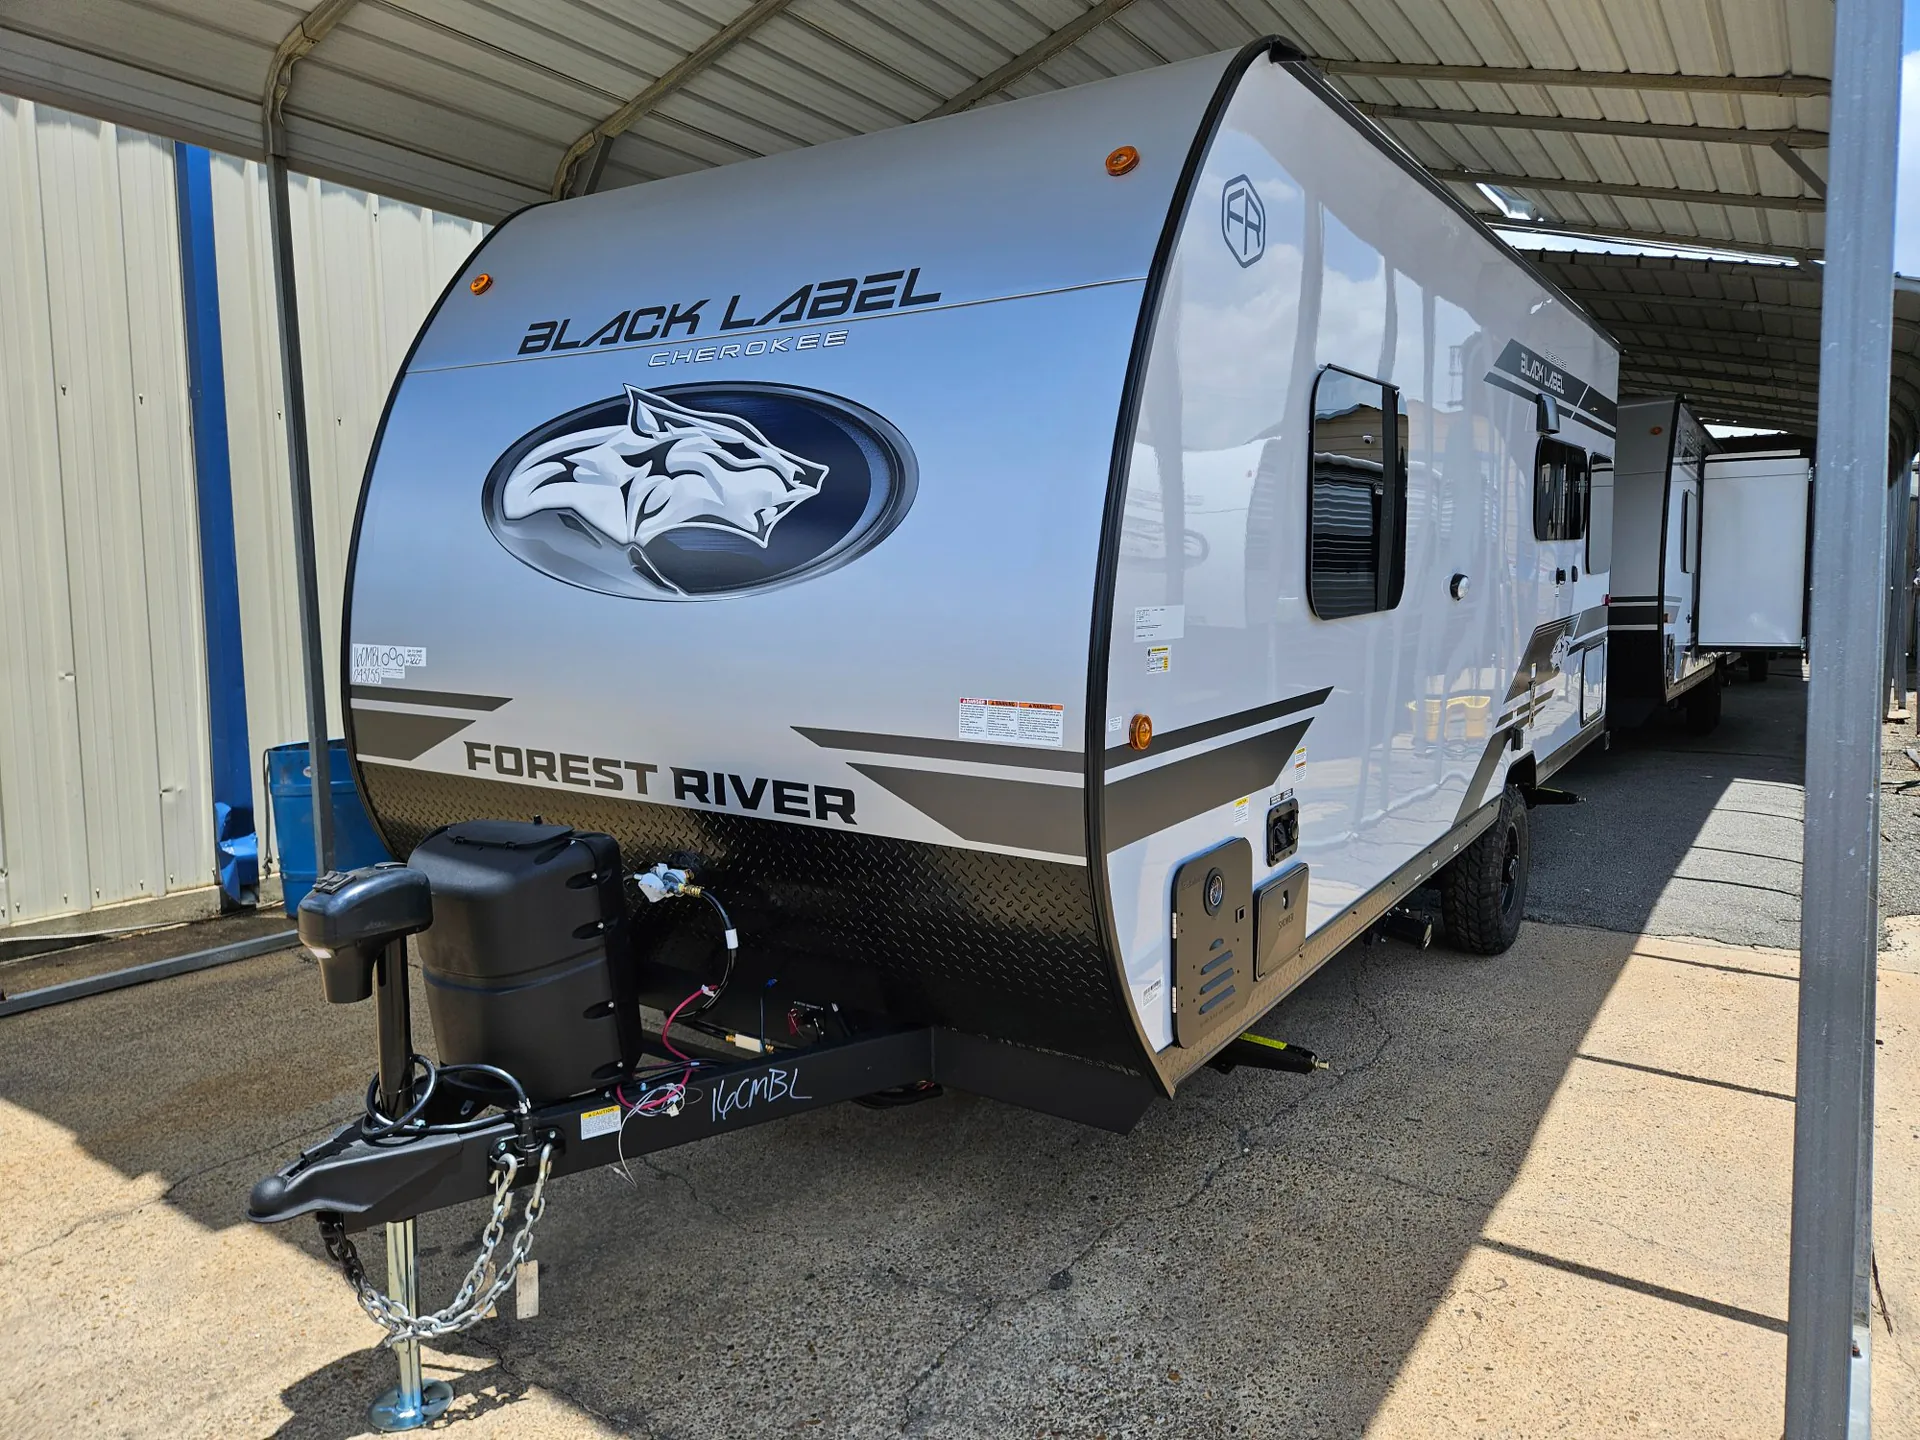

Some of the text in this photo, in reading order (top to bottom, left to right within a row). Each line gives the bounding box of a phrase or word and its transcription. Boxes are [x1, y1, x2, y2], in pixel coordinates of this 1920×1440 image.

[517, 267, 942, 356] BLACK LABEL
[647, 329, 850, 368] CHEROKEE
[1521, 352, 1565, 395] BLACK LABEL
[463, 740, 858, 825] FOREST RIVER
[592, 1108, 615, 1117] CAUTION
[711, 1068, 812, 1122] 16CMBL
